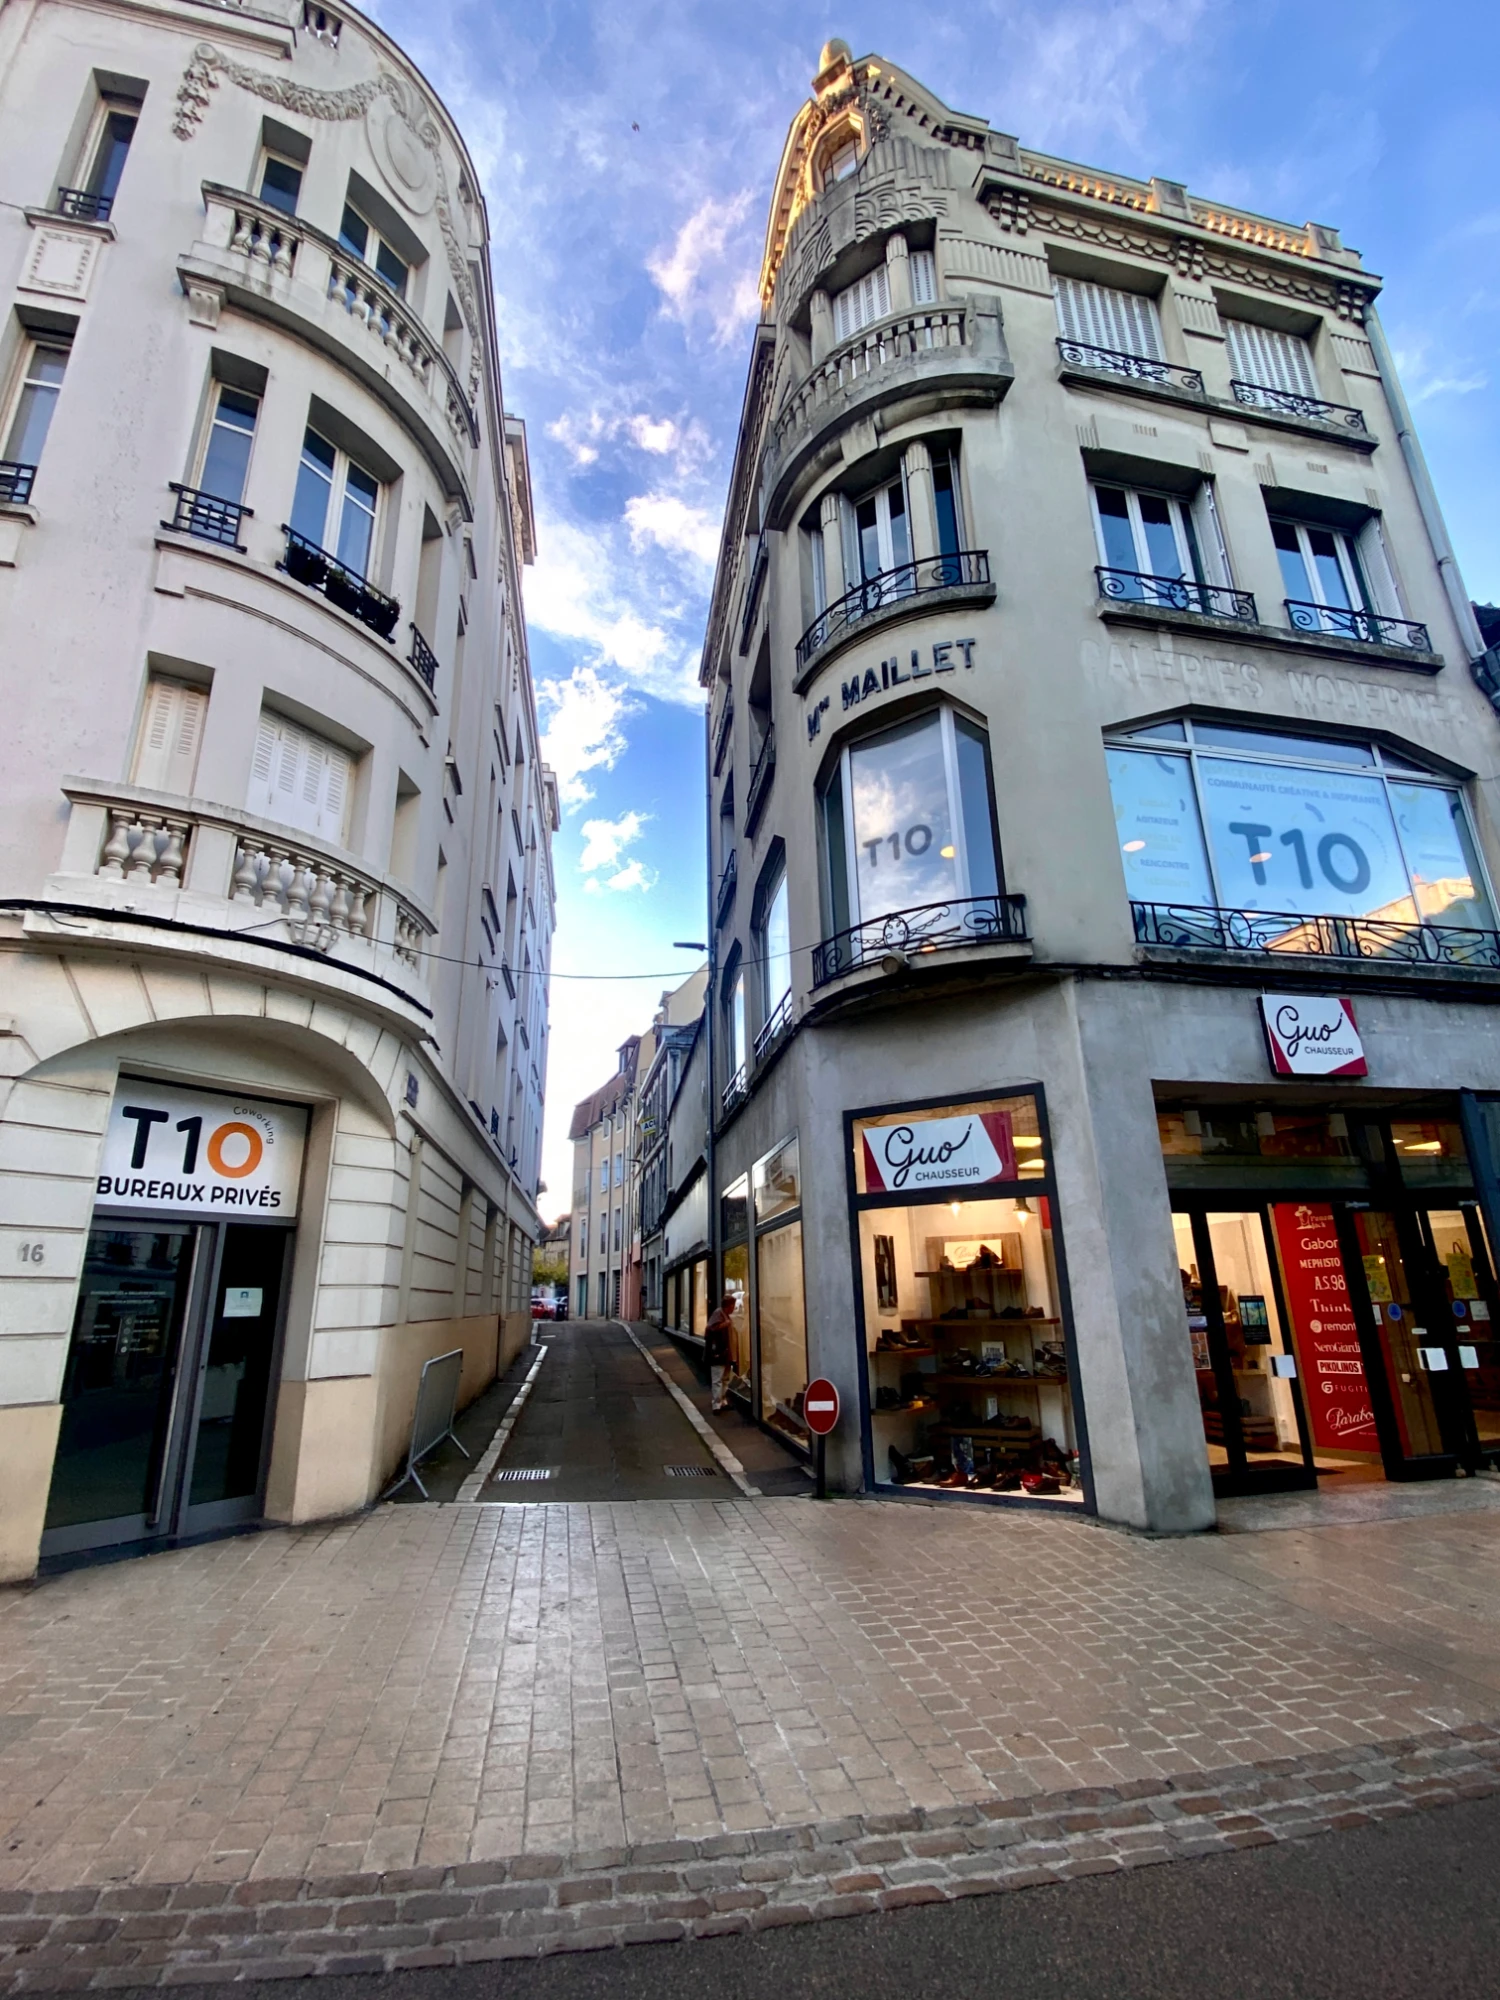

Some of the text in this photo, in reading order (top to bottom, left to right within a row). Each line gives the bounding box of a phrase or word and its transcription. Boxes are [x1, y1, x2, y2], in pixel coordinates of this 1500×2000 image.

[841, 638, 976, 710] MAILLET
[1079, 638, 1264, 698] GALERIES
[1304, 1045, 1354, 1056] CHAUSSEUR
[233, 1105, 275, 1145] Coworking
[914, 1166, 980, 1182] CHAUSSEUR
[96, 1176, 281, 1208] BUREAUX PRIVÉS
[1300, 1237, 1338, 1250] Gabor
[21, 1243, 44, 1262] 16
[1299, 1257, 1341, 1268] MEPHISTO
[1319, 1361, 1360, 1373] PIKOLINOS
